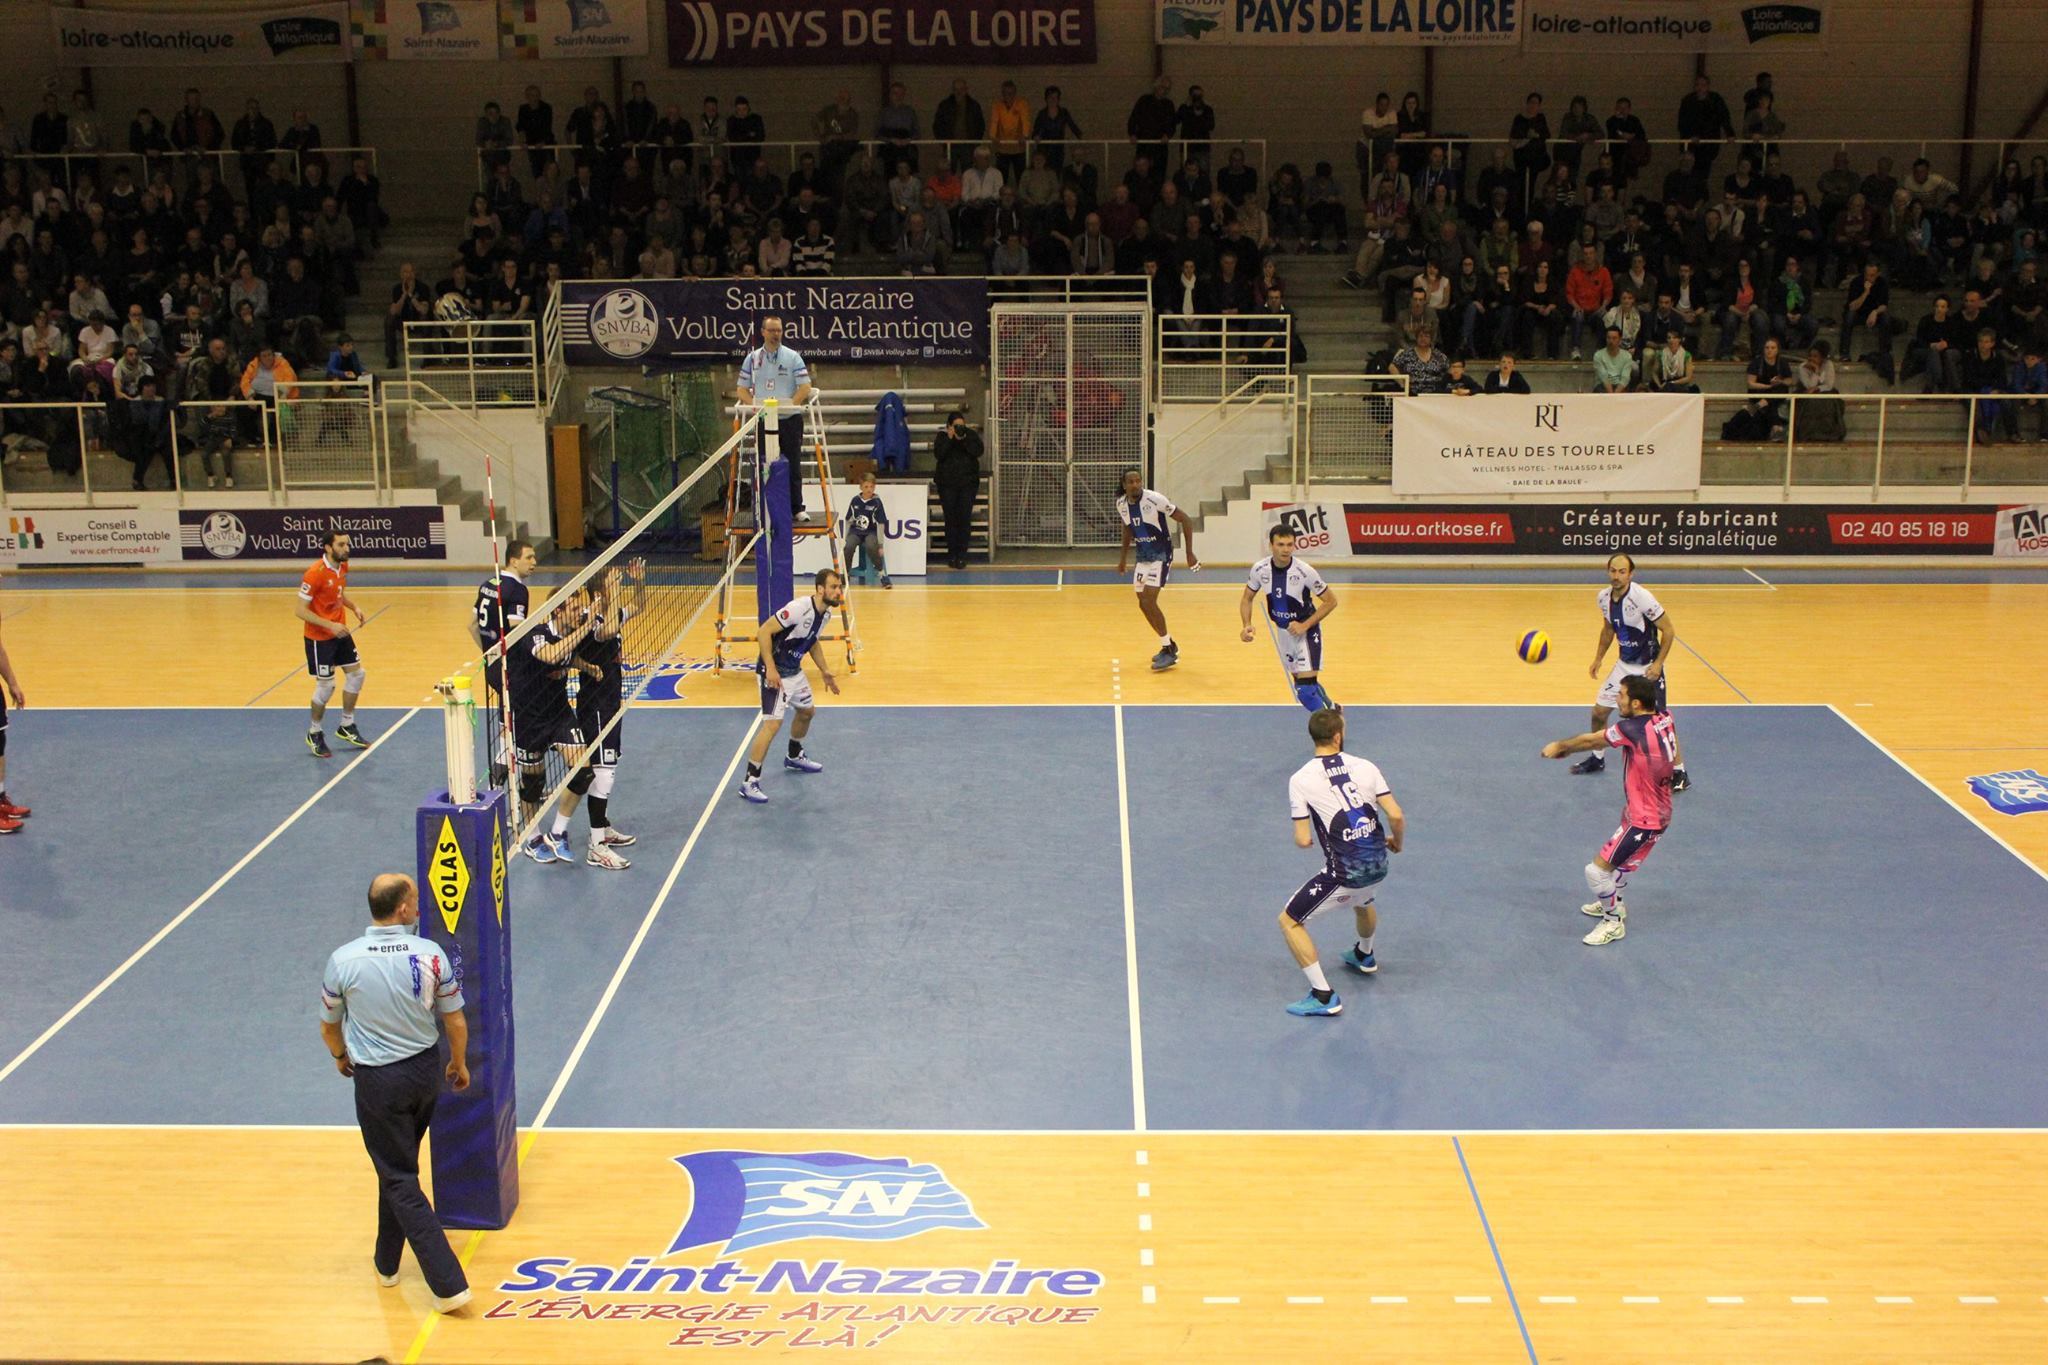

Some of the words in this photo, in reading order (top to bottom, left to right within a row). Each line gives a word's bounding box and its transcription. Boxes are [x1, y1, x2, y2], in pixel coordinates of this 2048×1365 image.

[1235, 0, 1314, 33] PAYS
[1320, 0, 1364, 32] DE
[1370, 0, 1412, 32] LA
[1418, 0, 1516, 33] LOIRE
[1752, 10, 1784, 20] Loire
[726, 10, 828, 49] PAYS
[842, 8, 893, 46] DE
[905, 9, 957, 47] LA
[969, 9, 1082, 47] LOIRE
[1752, 20, 1815, 33] Atlantique
[725, 286, 799, 310] Saint
[806, 286, 915, 310] Nazaire
[597, 319, 651, 336] SNVBA
[665, 316, 753, 345] Volley
[783, 316, 820, 340] all
[828, 314, 974, 345] Atlantique
[1441, 444, 1519, 458] CHÂTEAU
[1525, 446, 1555, 457] DES
[1561, 444, 1656, 457] TOURELLES
[1472, 465, 1516, 473] WELLNESS
[1554, 464, 1597, 472] THALASSO
[88, 520, 126, 530] Conseil
[129, 520, 137, 529] &
[283, 515, 326, 531] Saint
[329, 515, 392, 530] Nazaire
[1132, 517, 1141, 527] 17
[1283, 505, 1328, 535] Art
[1562, 509, 1667, 528] Créateur,
[1676, 509, 1779, 526] fabricant
[57, 531, 108, 543] Expertise
[111, 529, 171, 542] Comptable
[1360, 521, 1503, 538] www.artkose.fr
[1841, 521, 1865, 537] 02
[1870, 521, 1894, 537] 40
[1899, 521, 1923, 537] 85
[1928, 521, 1946, 537] 18
[1951, 521, 1969, 537] 18
[206, 532, 241, 544] SNVBA
[250, 534, 300, 551] Volley
[346, 532, 427, 551] Atlantique
[1562, 531, 1642, 549] enseigne
[1647, 531, 1664, 546] et
[1668, 529, 1778, 550] signalétique
[70, 547, 160, 556] www.cerfrance44.fr
[1275, 587, 1282, 598] 3
[479, 597, 491, 628] 5
[1330, 781, 1364, 812] 16
[439, 842, 459, 912] COLAS
[380, 944, 409, 953] errea
[764, 1178, 926, 1217] SN
[498, 1257, 1102, 1294] Saint-Nazaire
[669, 1327, 786, 1346] EST
